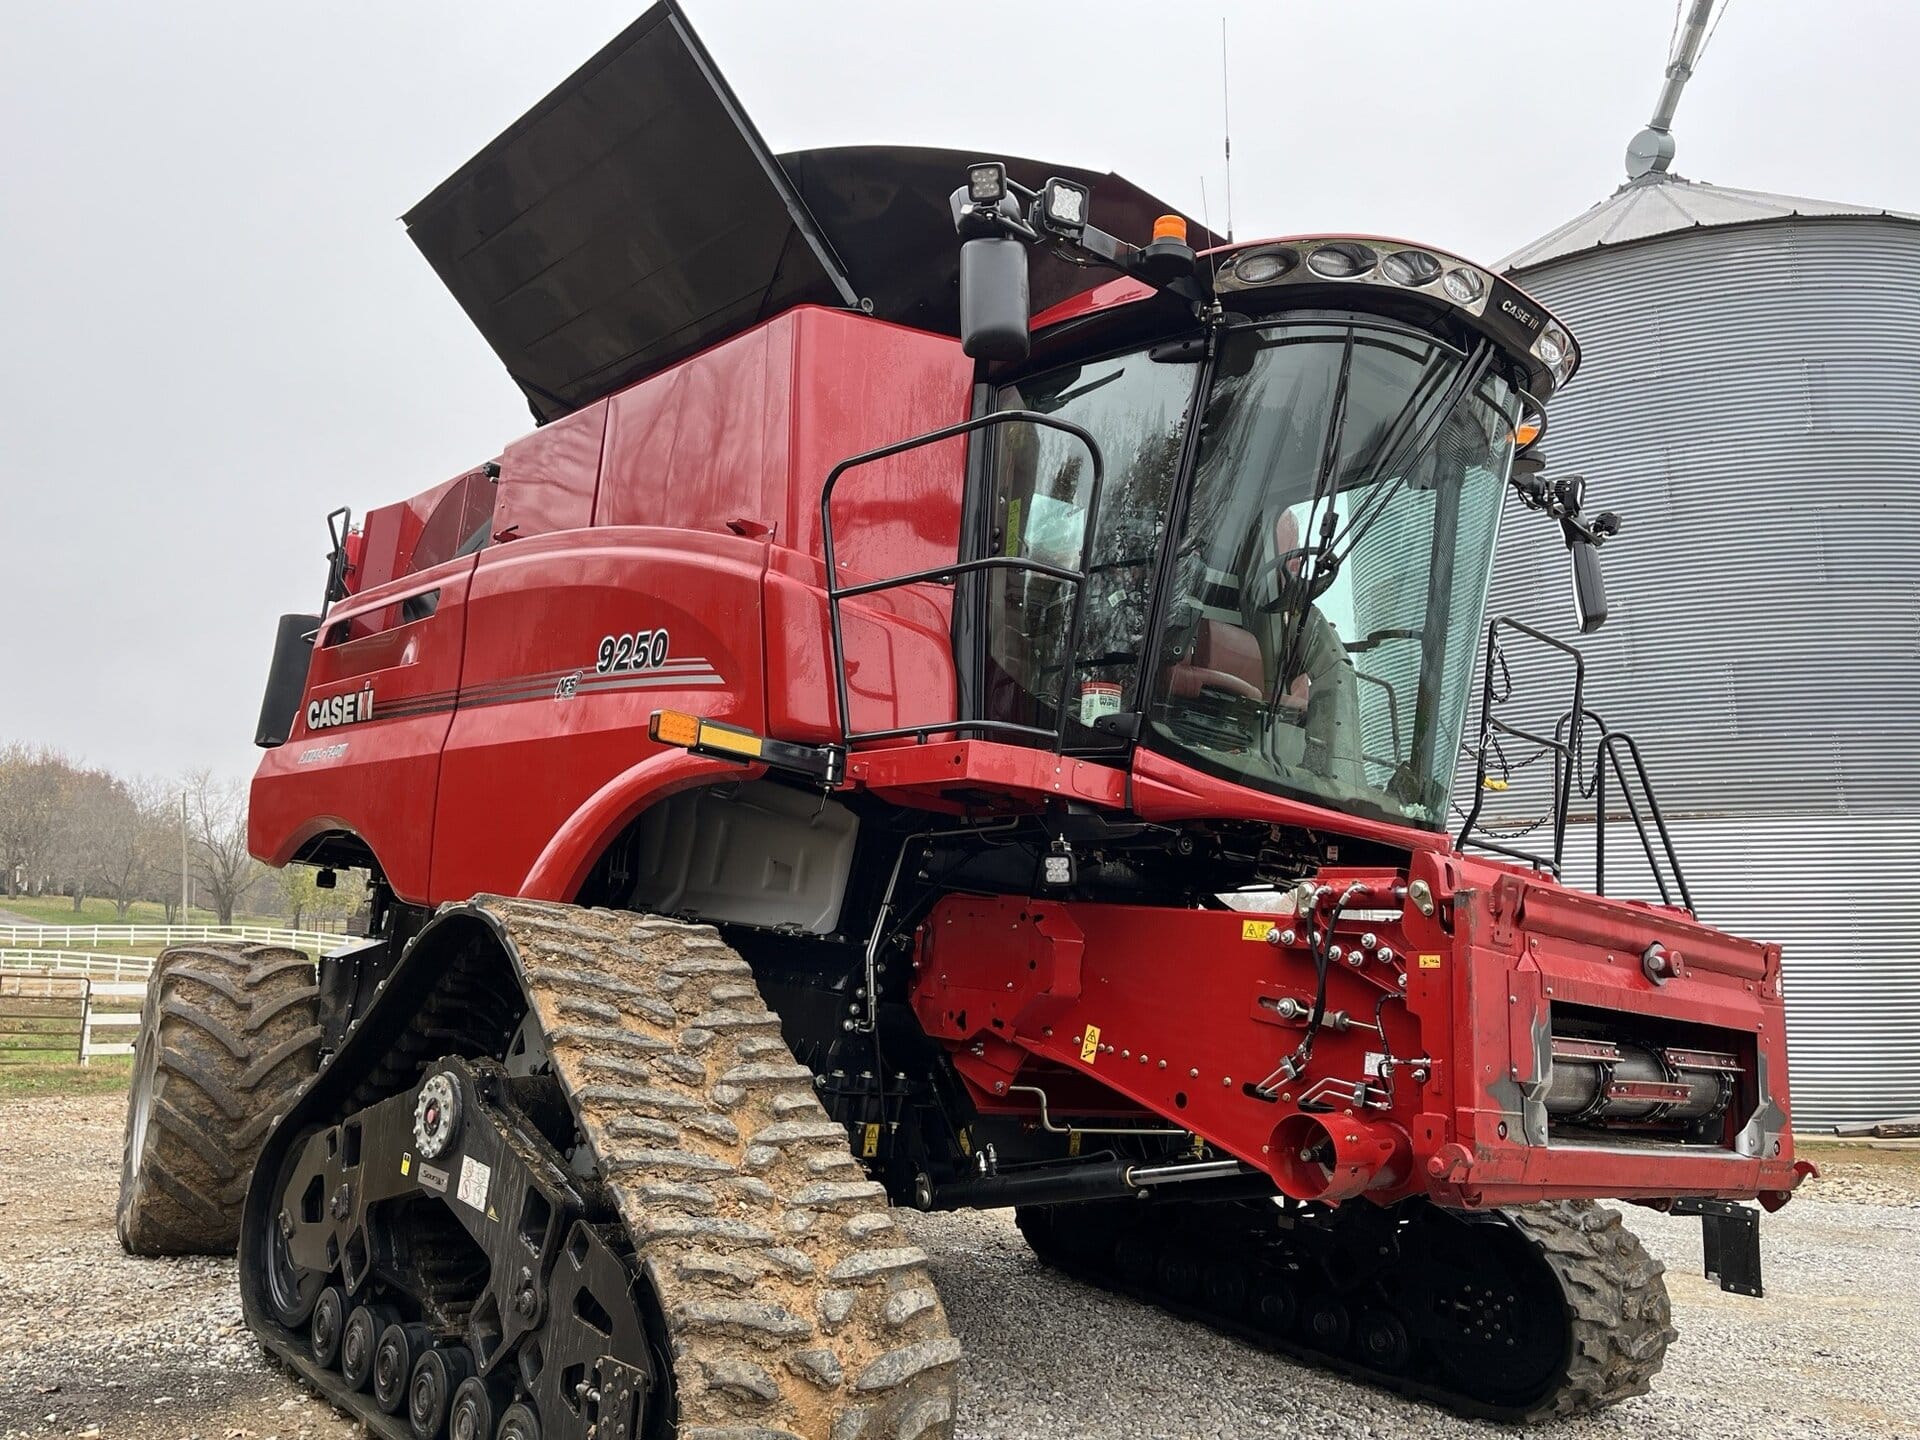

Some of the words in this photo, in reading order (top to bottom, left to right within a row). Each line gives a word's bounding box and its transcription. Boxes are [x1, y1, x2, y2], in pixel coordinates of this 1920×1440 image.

[1502, 300, 1530, 323] CASE
[596, 628, 669, 674] 9250
[307, 693, 355, 730] CASE
